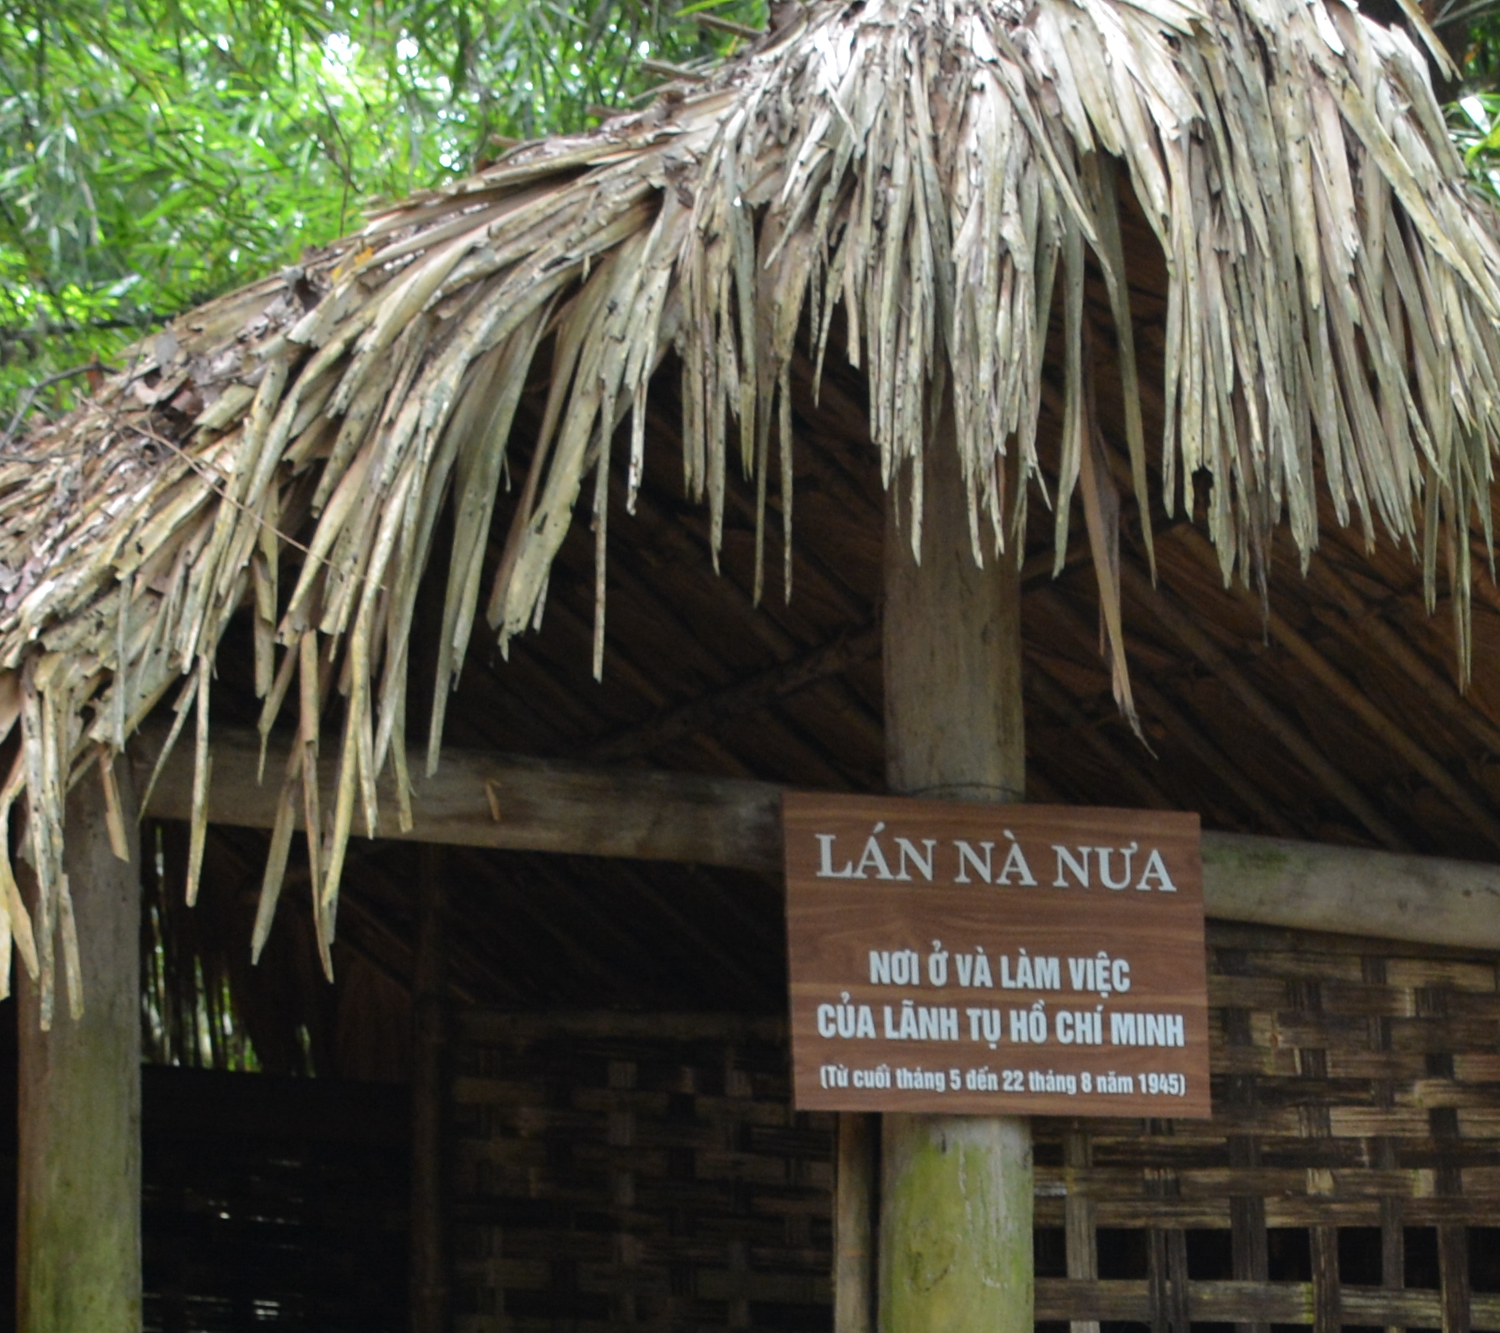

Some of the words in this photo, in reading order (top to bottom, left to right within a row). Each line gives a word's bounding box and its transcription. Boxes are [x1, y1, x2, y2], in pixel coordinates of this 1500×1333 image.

[815, 822, 937, 881] LÁN
[953, 830, 1038, 887] NÀ
[1052, 842, 1178, 892] NƯA
[869, 949, 919, 986] NƠI
[928, 940, 949, 987] Ở
[955, 946, 993, 989] VÀ
[1000, 948, 1061, 990] LÀM
[1068, 950, 1131, 998] VIỆC
[816, 992, 876, 1040] CỦA
[884, 1000, 959, 1042] LÃNH
[966, 1009, 1000, 1050] TỤ
[1010, 1000, 1047, 1045] HỒ
[1055, 1005, 1102, 1046] CHÍ
[1110, 1012, 1185, 1047] MINH
[820, 1064, 849, 1090] (Từ
[853, 1063, 891, 1090] cuối
[896, 1067, 945, 1092] tháng
[950, 1069, 961, 1090] 5
[966, 1066, 998, 1092] đến
[1003, 1070, 1024, 1093] 22
[1029, 1070, 1078, 1095] tháng
[1081, 1073, 1092, 1093] 8
[1096, 1073, 1134, 1095] năm
[1138, 1073, 1187, 1097] 1945)
